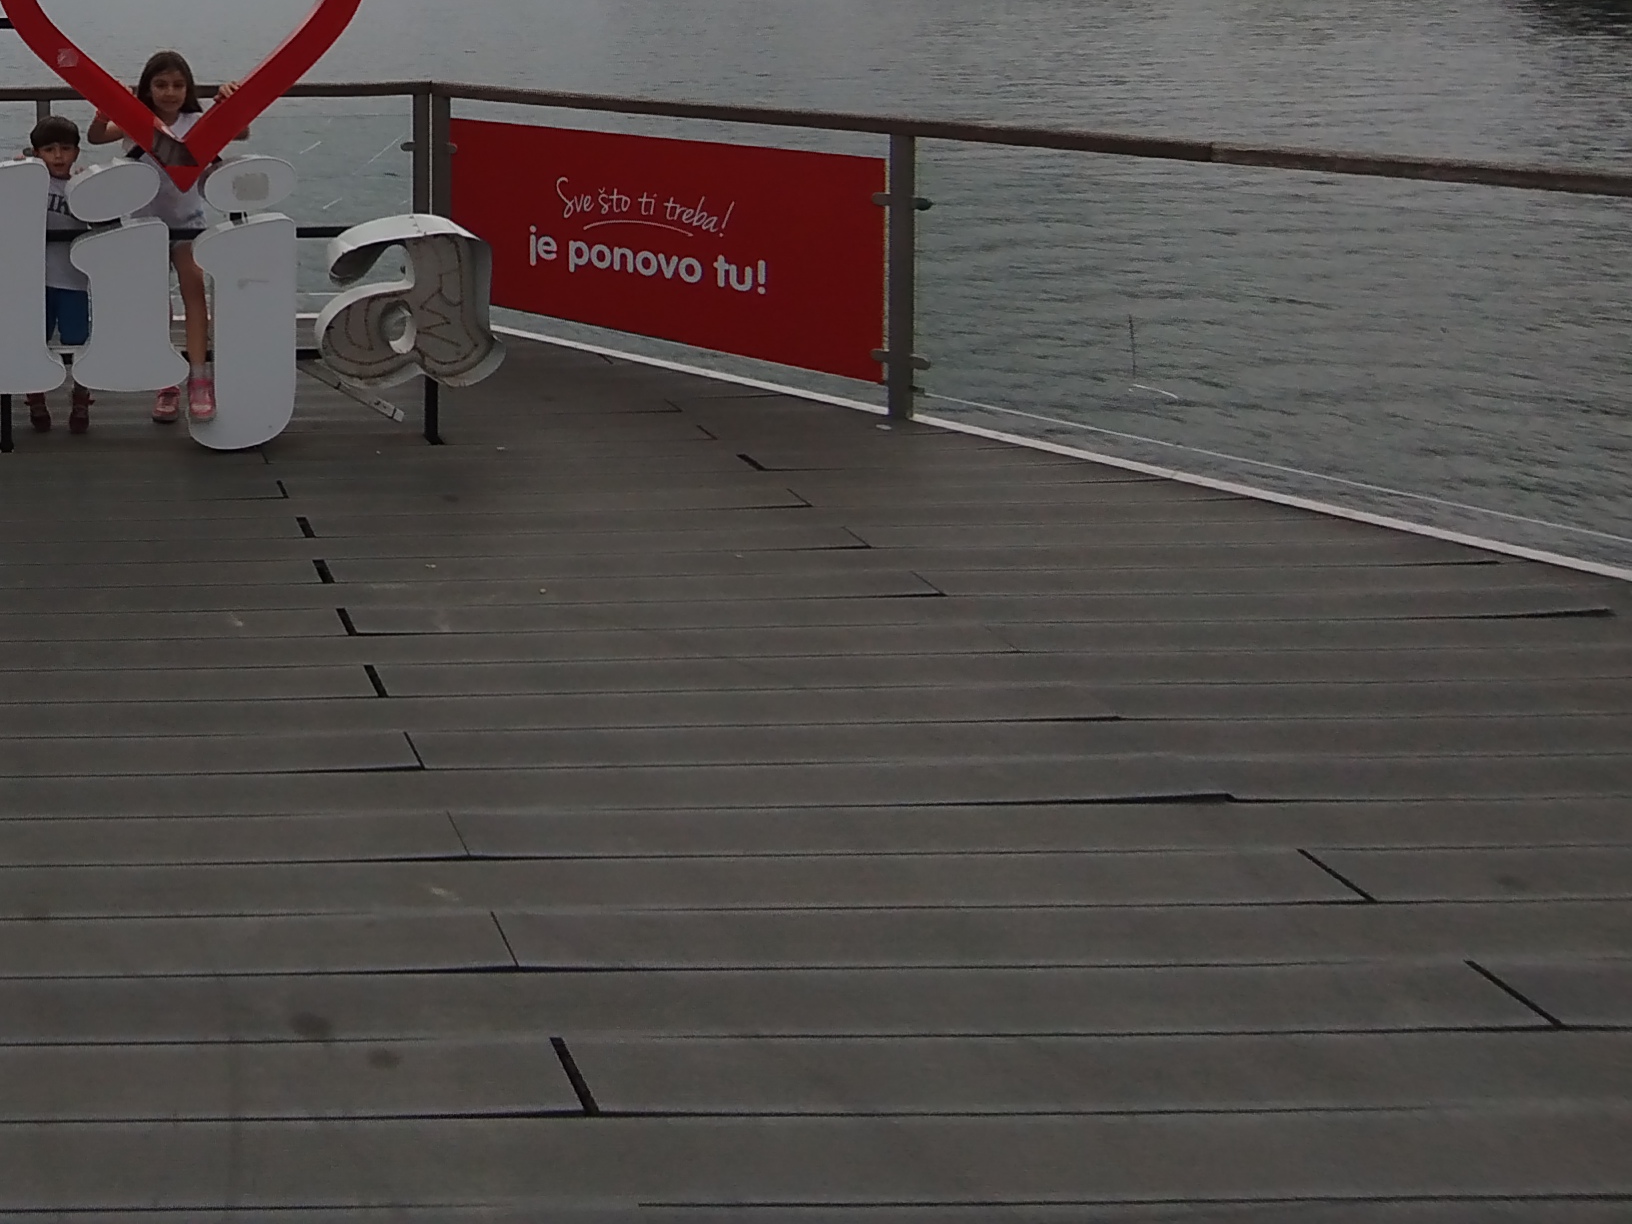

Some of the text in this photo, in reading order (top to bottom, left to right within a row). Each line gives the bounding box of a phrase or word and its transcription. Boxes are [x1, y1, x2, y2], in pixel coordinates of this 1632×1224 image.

[555, 176, 736, 238] Sve što ti treba!
[529, 225, 767, 296] je ponovo tu!
